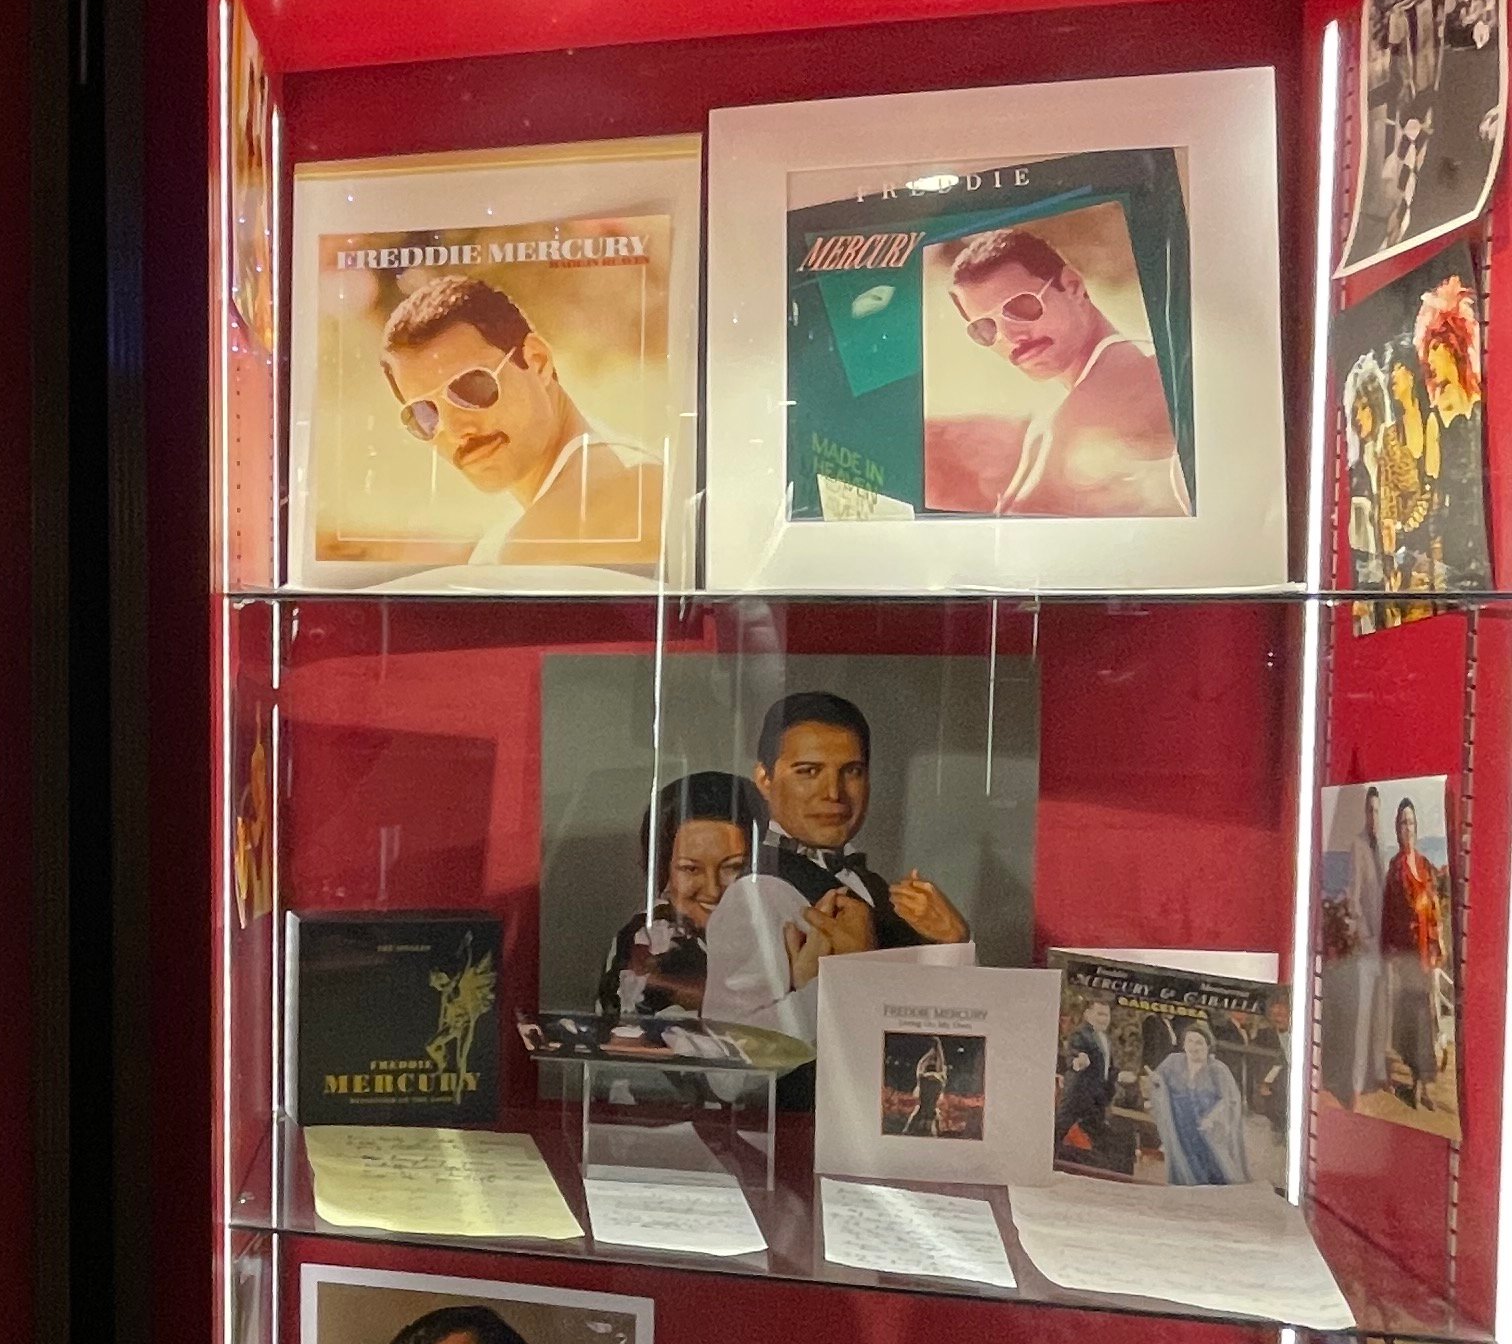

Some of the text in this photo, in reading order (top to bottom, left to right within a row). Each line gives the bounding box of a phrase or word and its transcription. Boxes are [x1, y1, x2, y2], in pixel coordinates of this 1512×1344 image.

[338, 235, 650, 270] FREDDIE MERCURY
[796, 231, 927, 272] MERCURY
[812, 432, 885, 488] MADE IN
[323, 1072, 481, 1094] MERCURY
